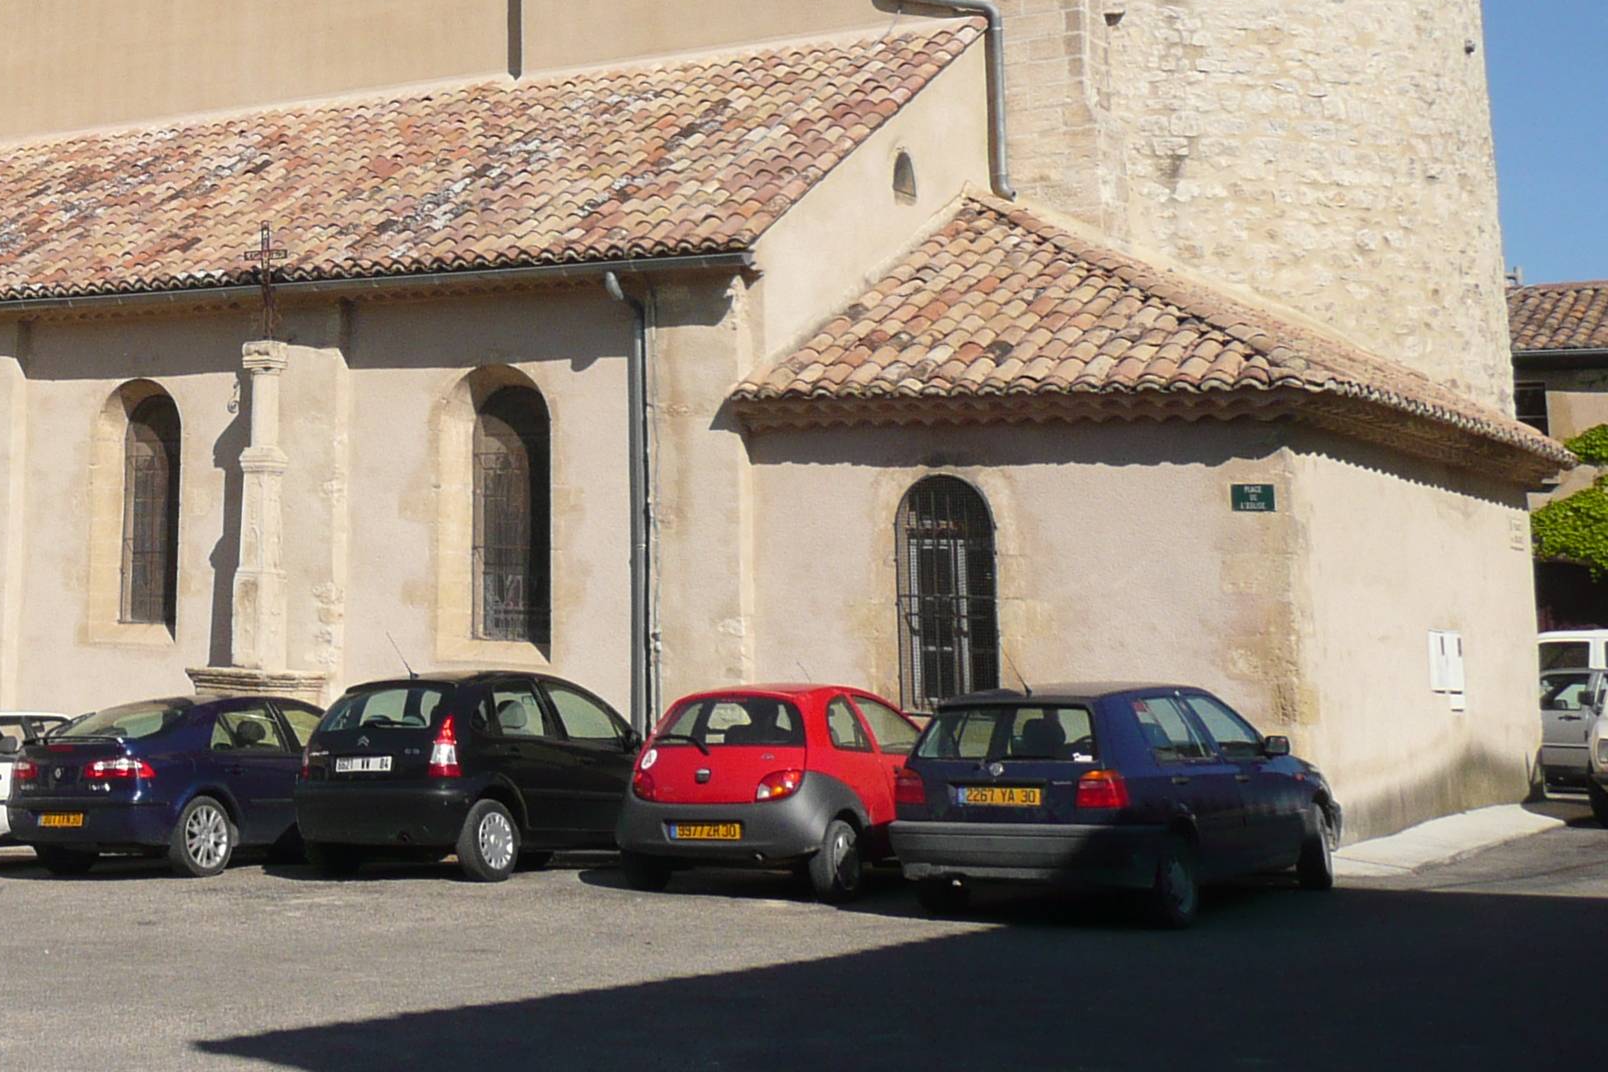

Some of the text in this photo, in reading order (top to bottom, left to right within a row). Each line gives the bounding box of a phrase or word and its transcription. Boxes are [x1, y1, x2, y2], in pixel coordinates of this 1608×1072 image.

[967, 788, 1036, 804] 2267 YA 30
